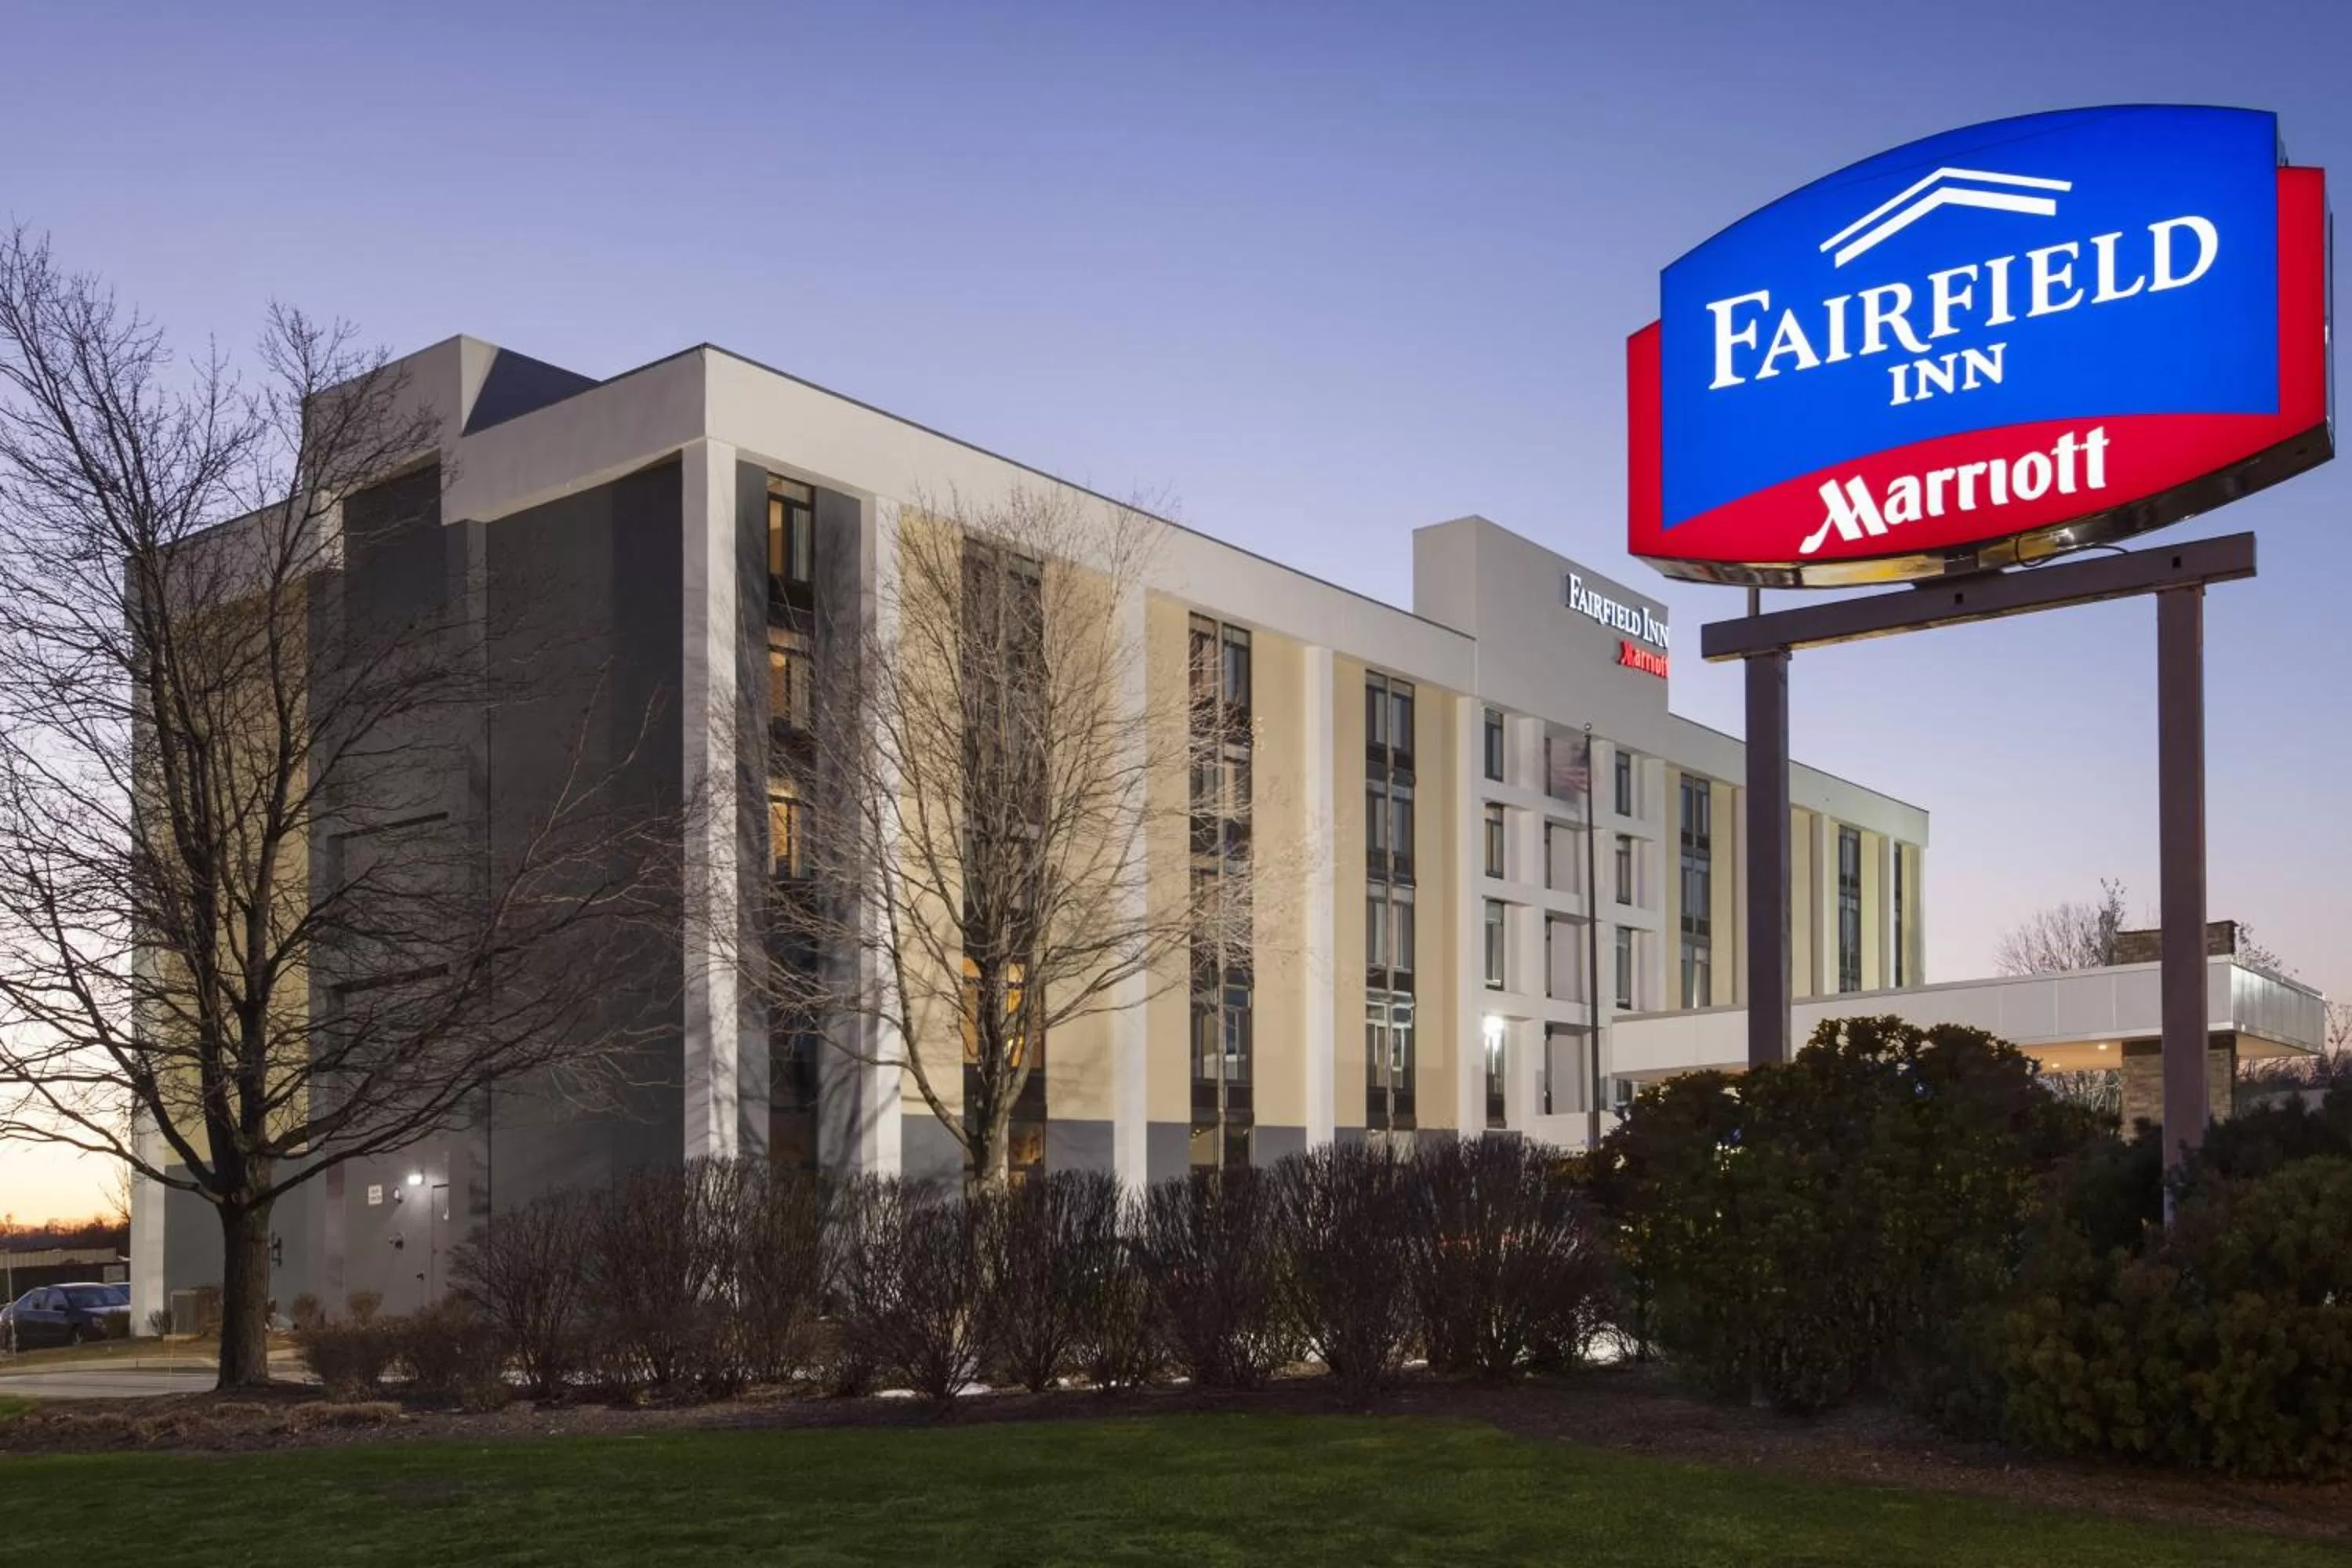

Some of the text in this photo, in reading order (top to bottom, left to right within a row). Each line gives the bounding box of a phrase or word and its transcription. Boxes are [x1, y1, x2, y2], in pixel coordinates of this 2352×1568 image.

[1704, 215, 2219, 390] FAIRFIELD
[1888, 343, 2008, 406] INN
[1799, 426, 2110, 554] Marriott
[1569, 572, 1669, 648] FAIRFIELD INN
